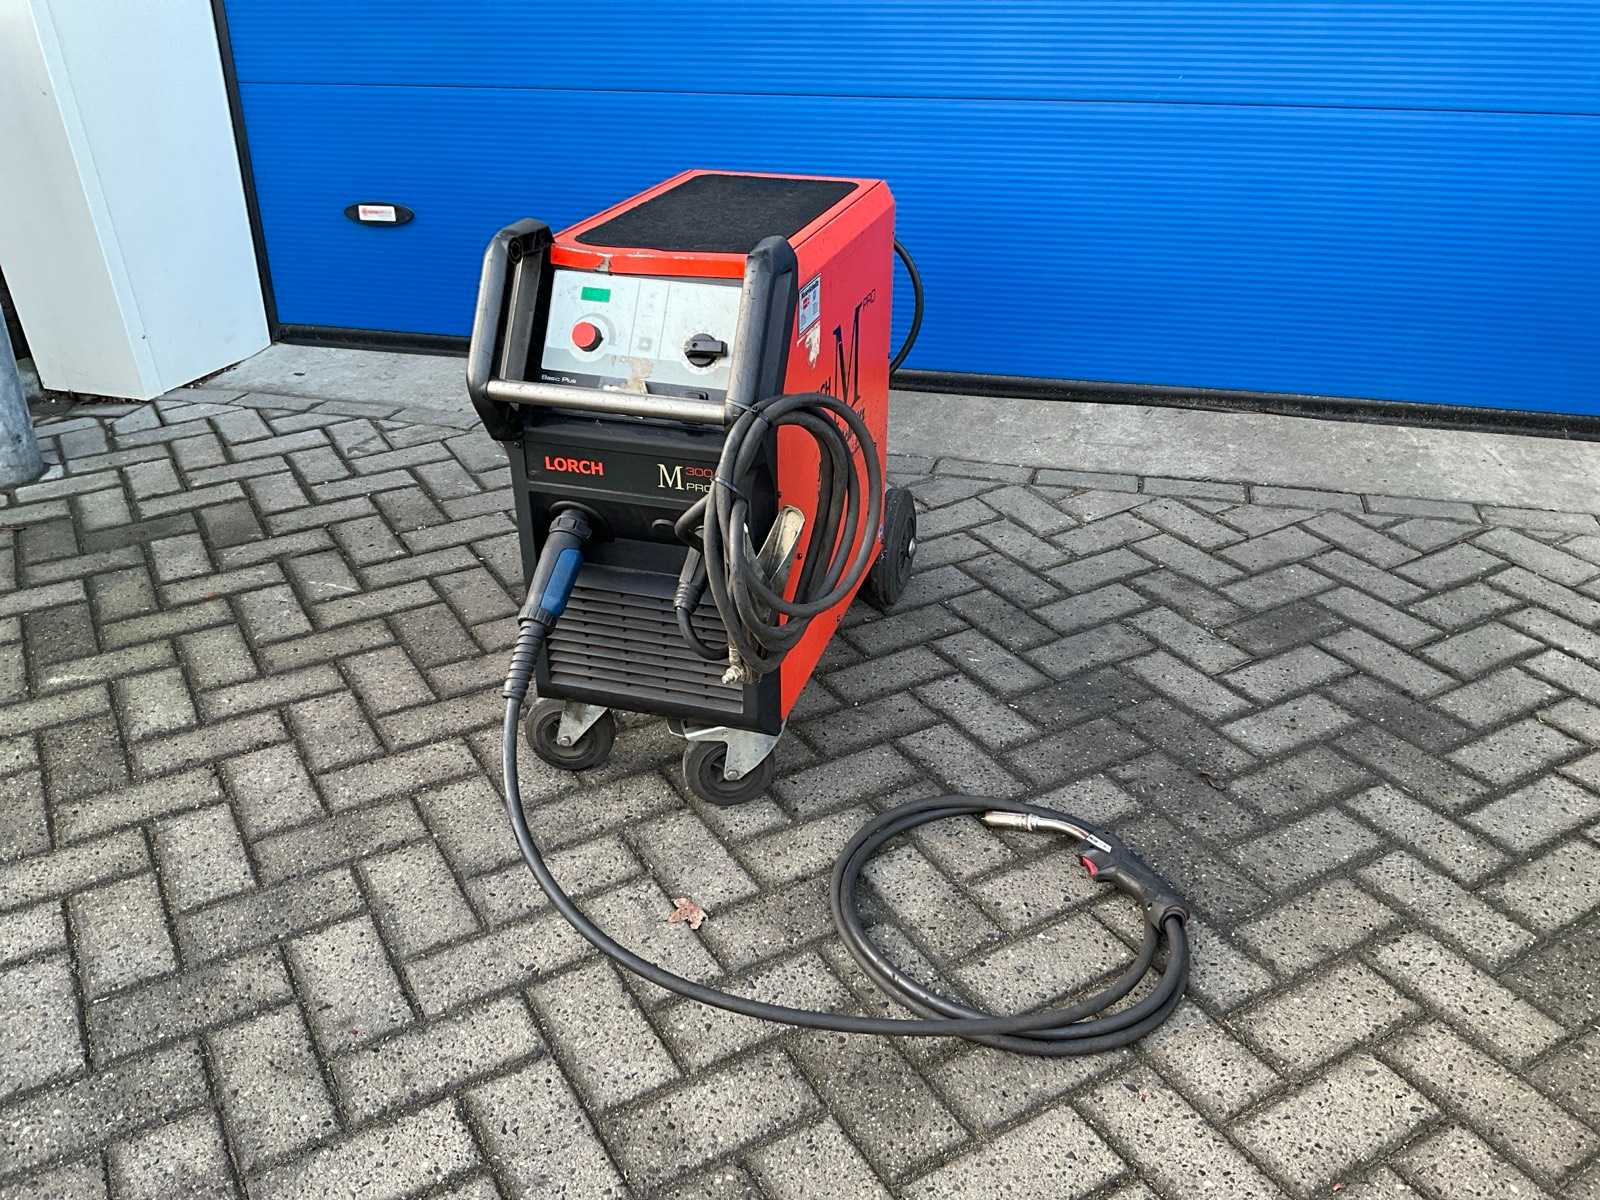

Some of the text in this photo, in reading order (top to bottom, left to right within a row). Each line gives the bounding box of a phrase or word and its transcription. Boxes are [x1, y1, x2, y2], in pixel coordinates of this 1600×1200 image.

[544, 455, 605, 476] LORCH
[656, 463, 713, 491] M 300
